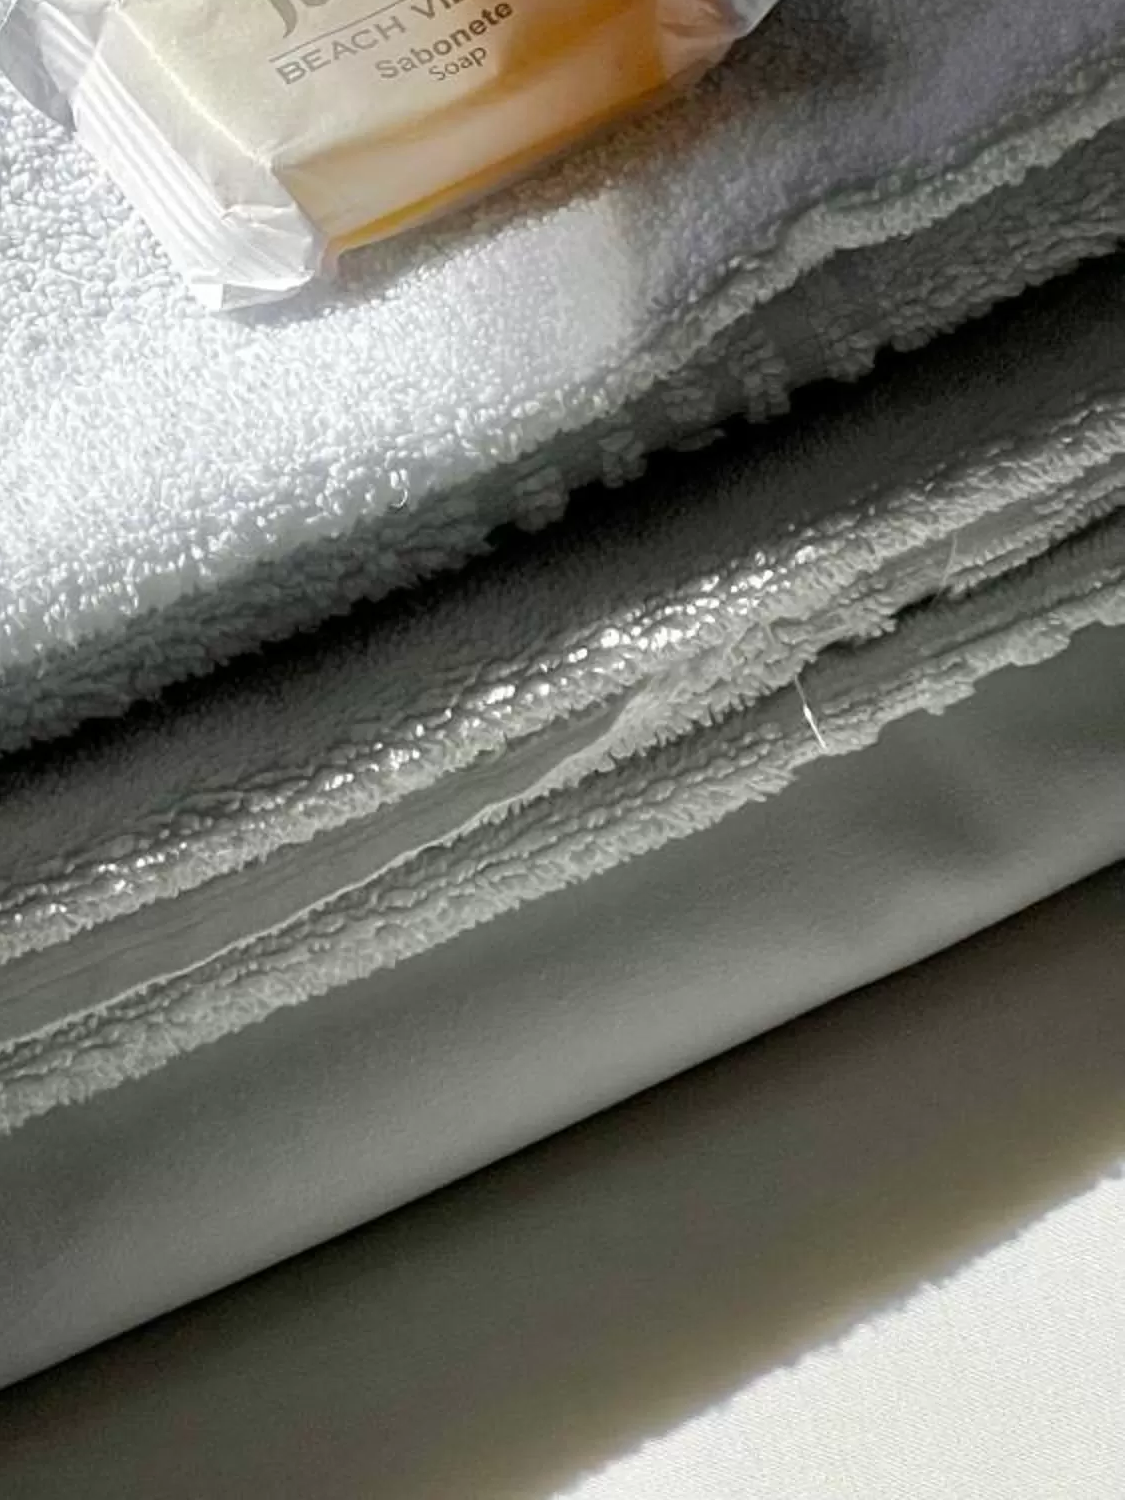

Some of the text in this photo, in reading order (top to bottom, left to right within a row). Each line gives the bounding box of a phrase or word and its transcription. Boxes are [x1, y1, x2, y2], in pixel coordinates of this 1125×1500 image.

[274, 16, 406, 85] BEACH
[374, 1, 514, 80] Sabonete
[428, 47, 488, 81] Soap
